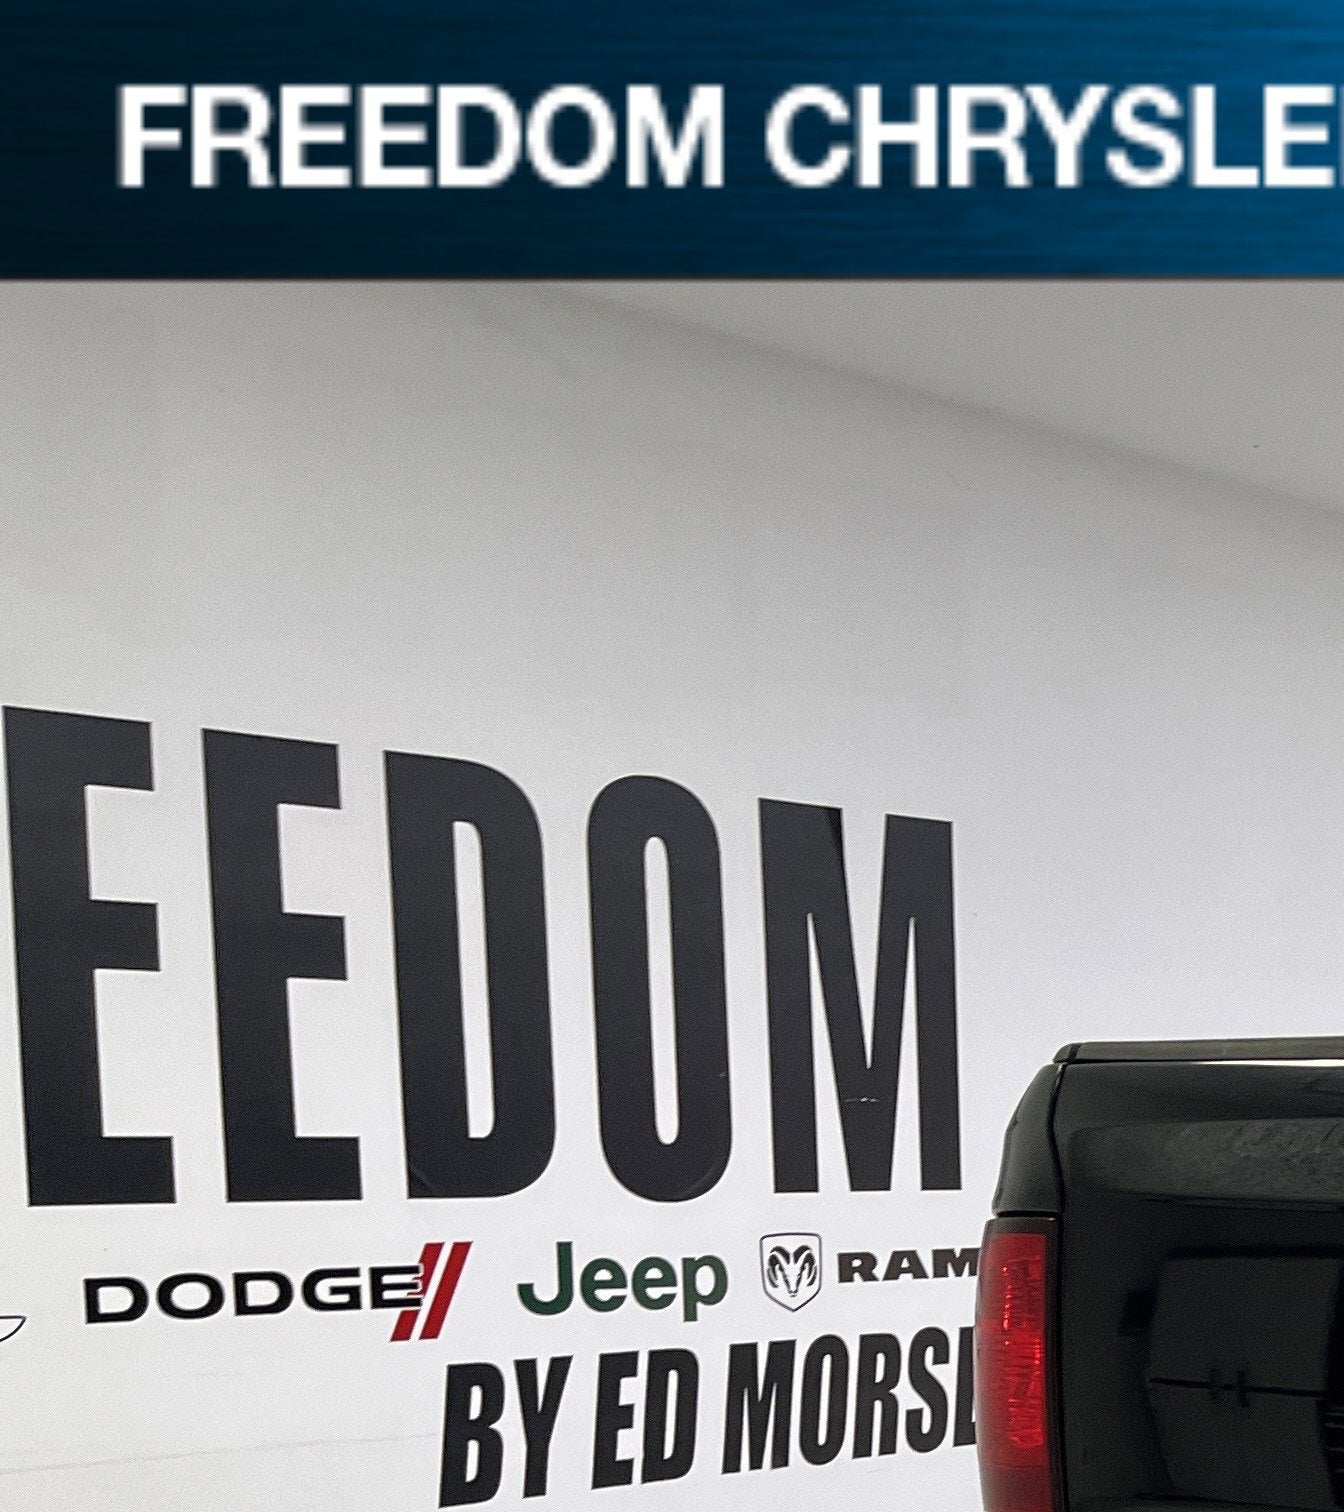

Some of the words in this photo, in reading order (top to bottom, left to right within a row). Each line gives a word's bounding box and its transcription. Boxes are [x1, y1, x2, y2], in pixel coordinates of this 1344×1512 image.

[83, 1264, 424, 1325] DODGE
[517, 1240, 728, 1323] Jeep
[837, 1247, 981, 1283] RAM
[438, 1354, 574, 1508] BY
[590, 1347, 700, 1491] ED
